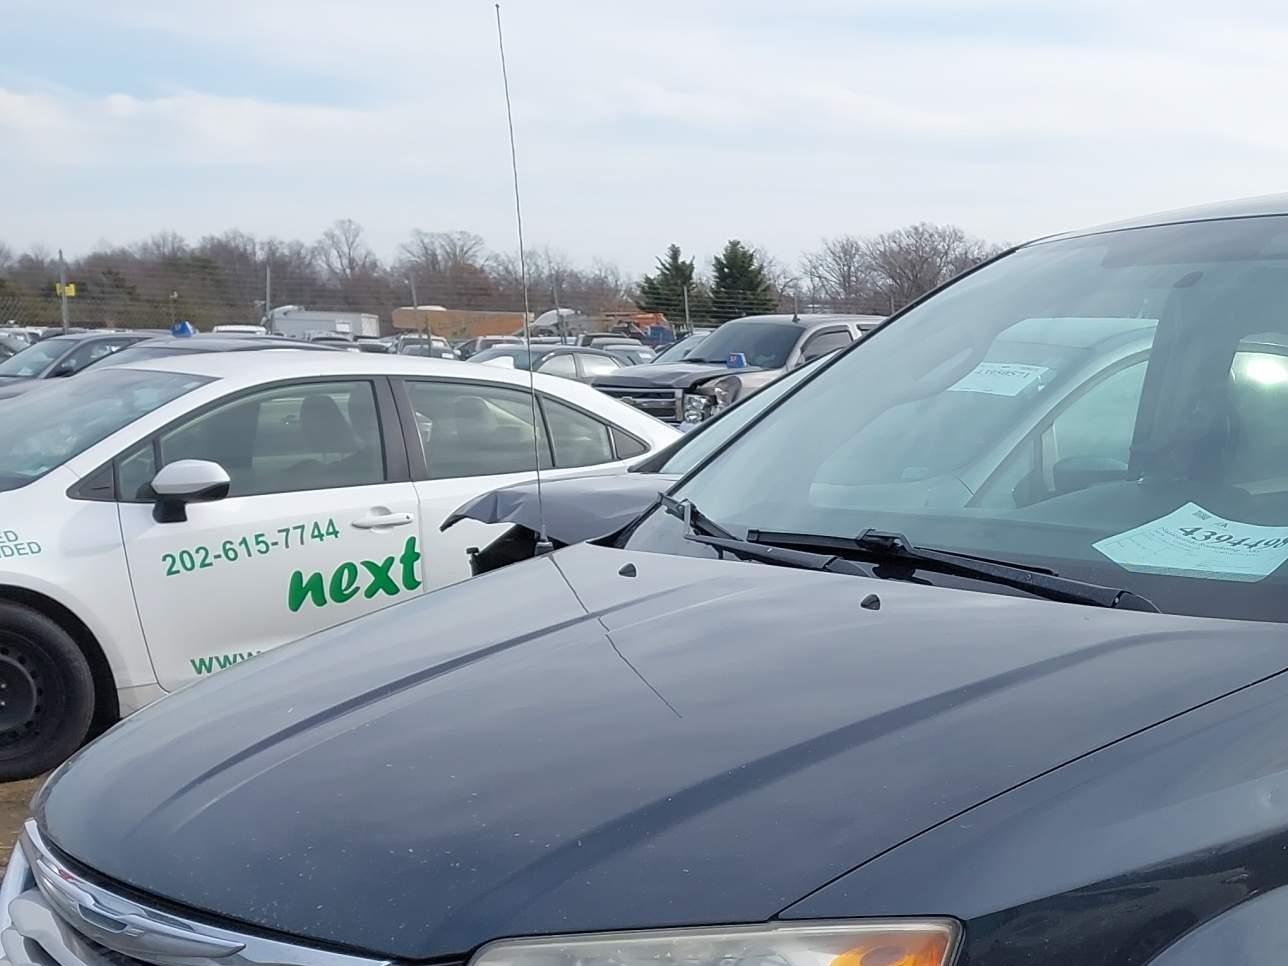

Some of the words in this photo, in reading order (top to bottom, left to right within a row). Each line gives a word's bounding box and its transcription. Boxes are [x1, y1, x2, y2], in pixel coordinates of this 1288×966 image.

[0, 541, 42, 558] DED
[162, 518, 340, 576] 202-615-7744
[288, 536, 422, 612] next
